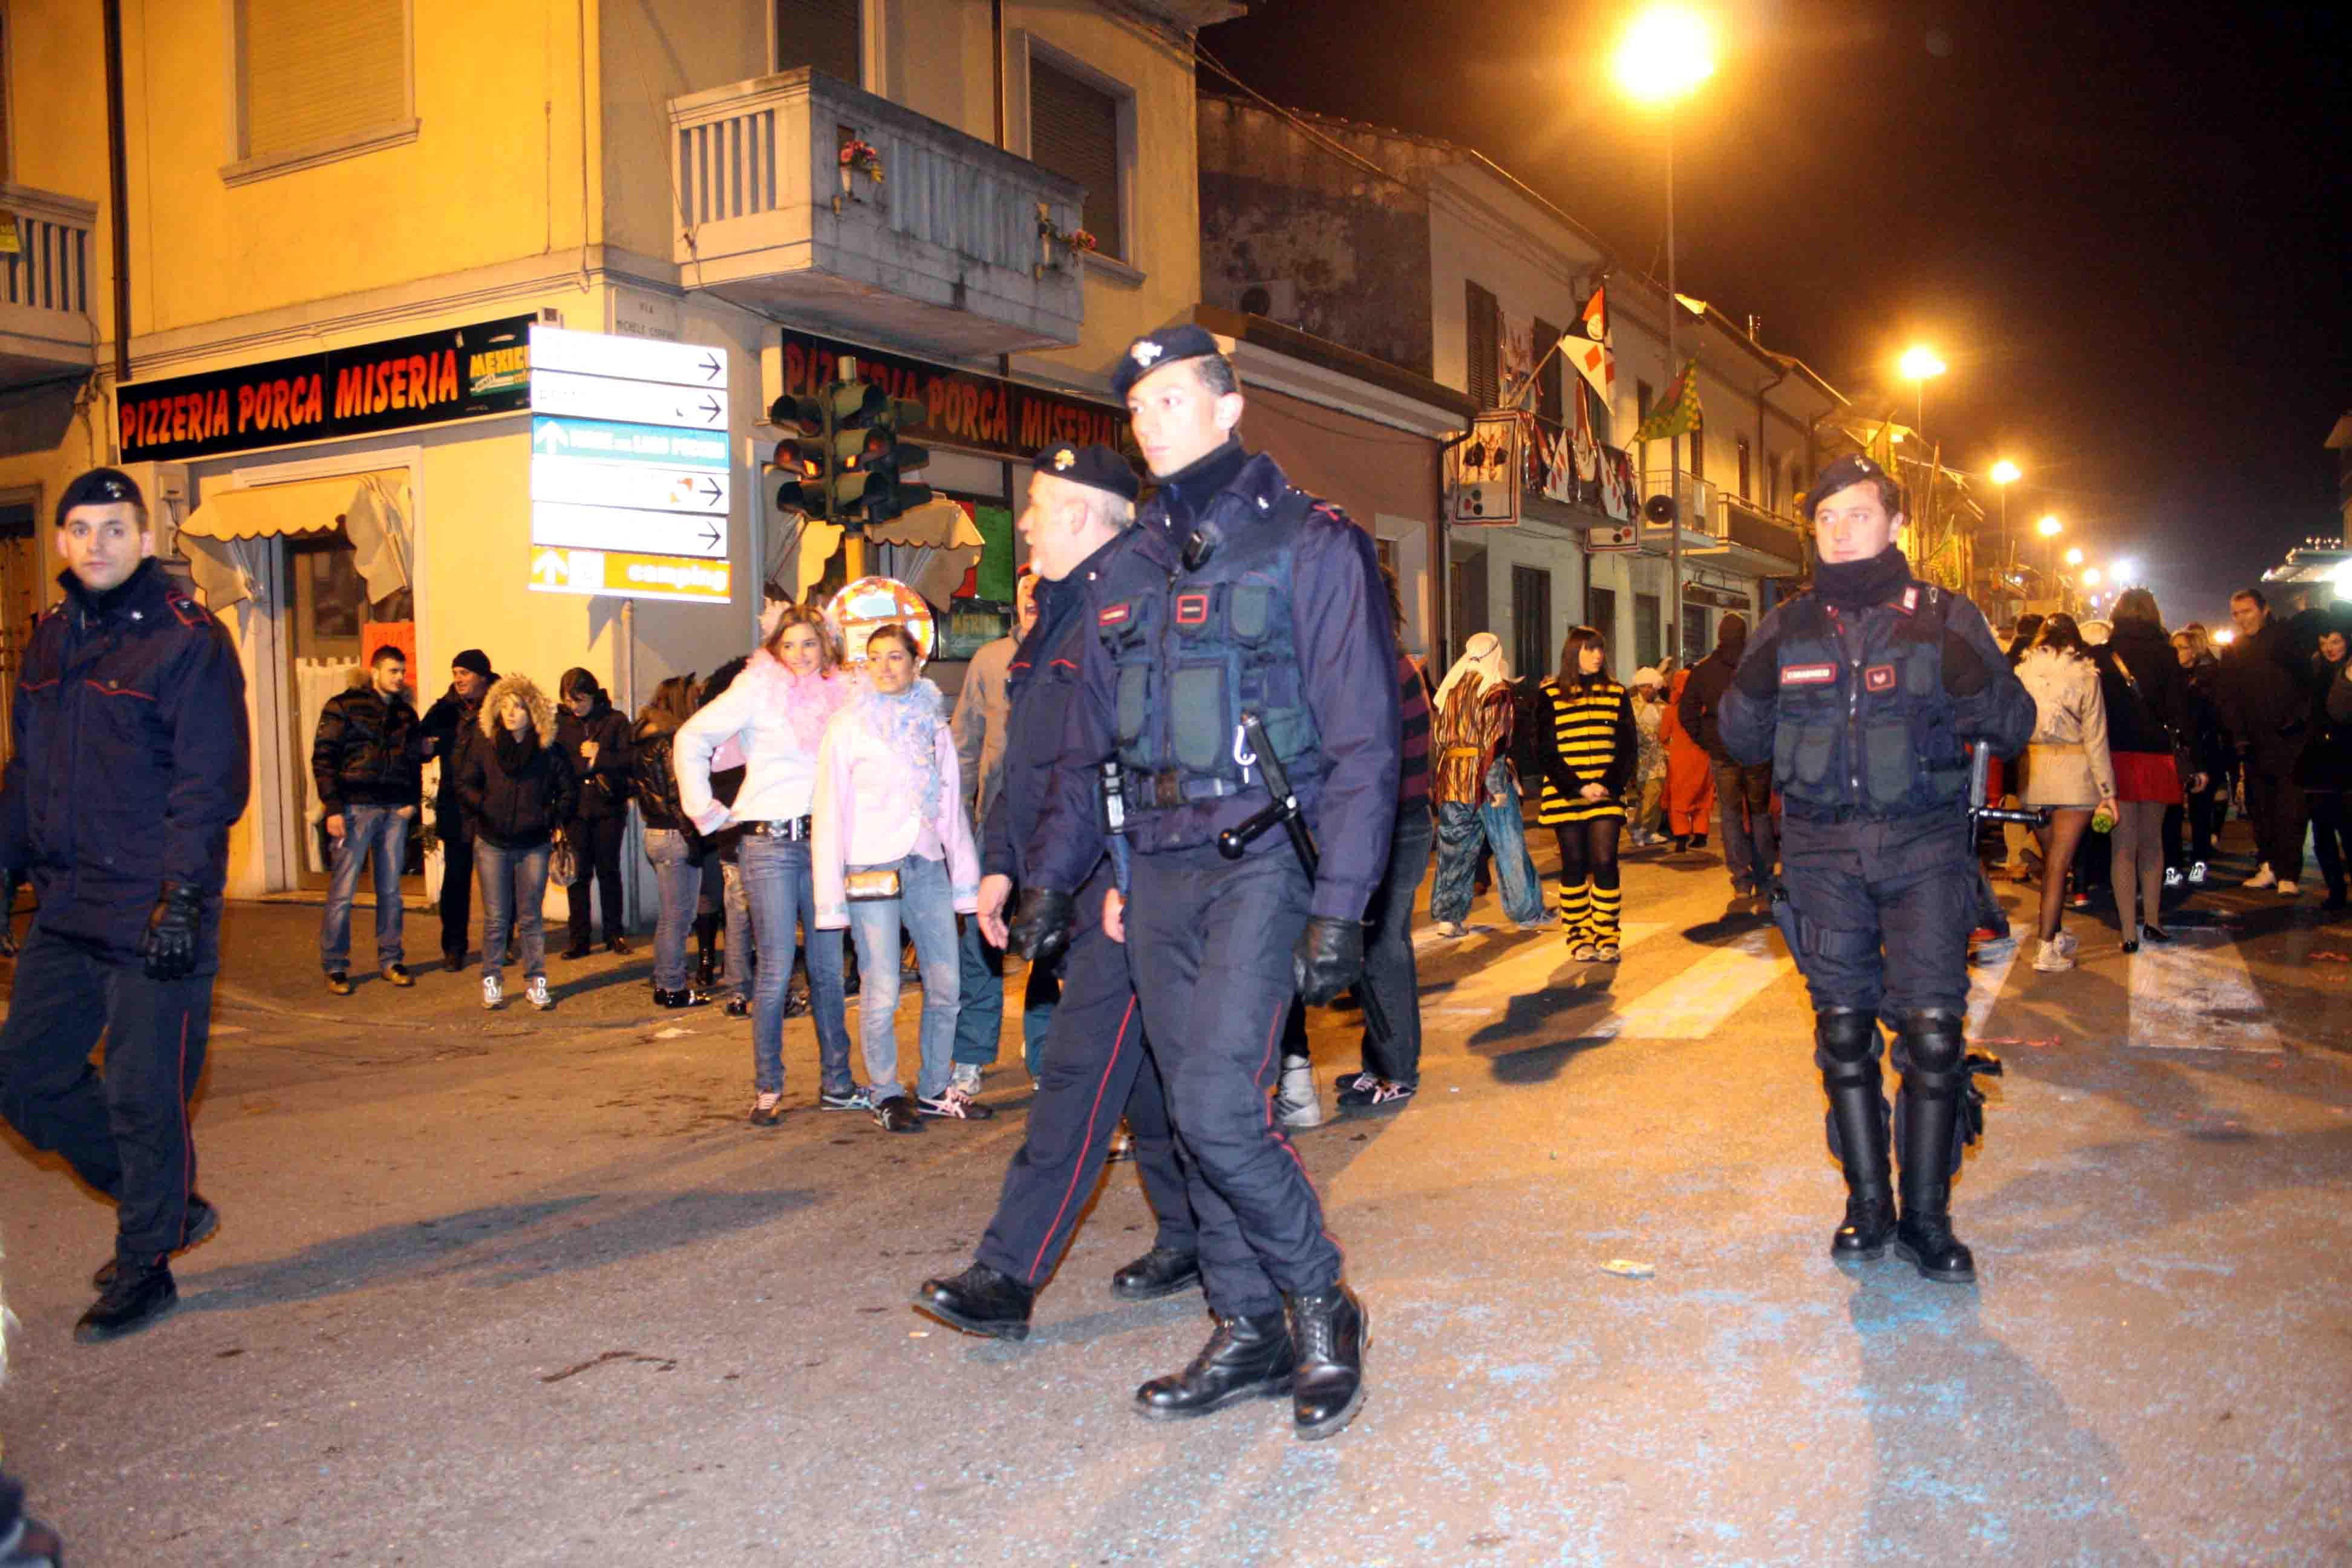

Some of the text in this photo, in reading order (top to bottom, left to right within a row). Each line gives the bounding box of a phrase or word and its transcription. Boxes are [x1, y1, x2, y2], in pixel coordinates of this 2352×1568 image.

[122, 348, 458, 449] PIZZERIA PORCA MISERIA
[784, 342, 1113, 449] PIZERIA PORCA MISERIA
[626, 563, 728, 592] camping
